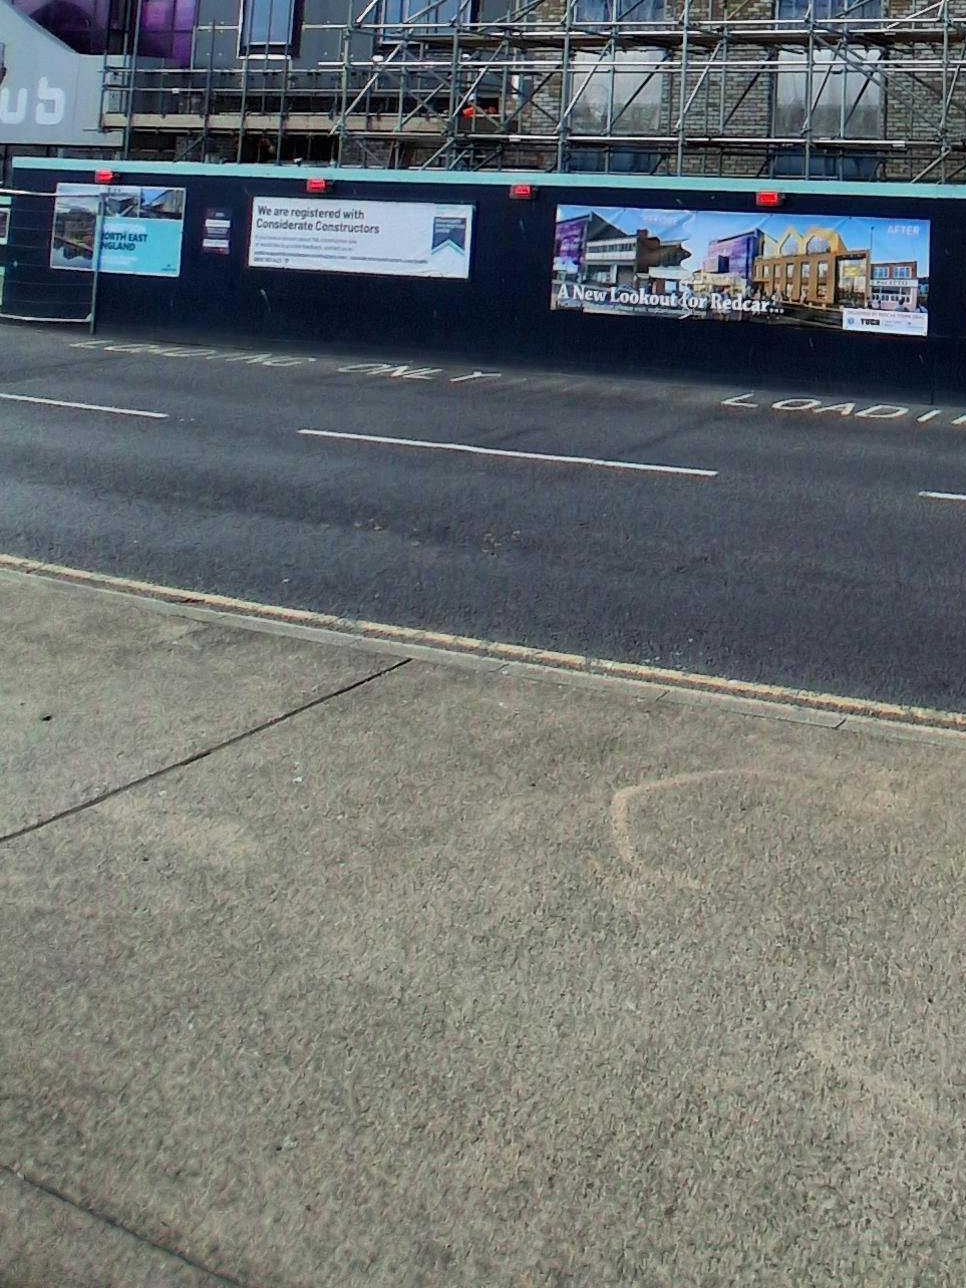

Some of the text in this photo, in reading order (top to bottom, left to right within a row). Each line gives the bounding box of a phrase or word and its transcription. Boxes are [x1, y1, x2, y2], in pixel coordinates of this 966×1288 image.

[257, 205, 365, 220] We are registered with
[256, 218, 380, 234] Considerate Constructors
[887, 225, 920, 236] AFTER
[130, 233, 148, 243] EAST
[557, 284, 569, 300] A
[573, 285, 607, 302] New
[611, 286, 677, 307] Lookout
[680, 289, 707, 310] for
